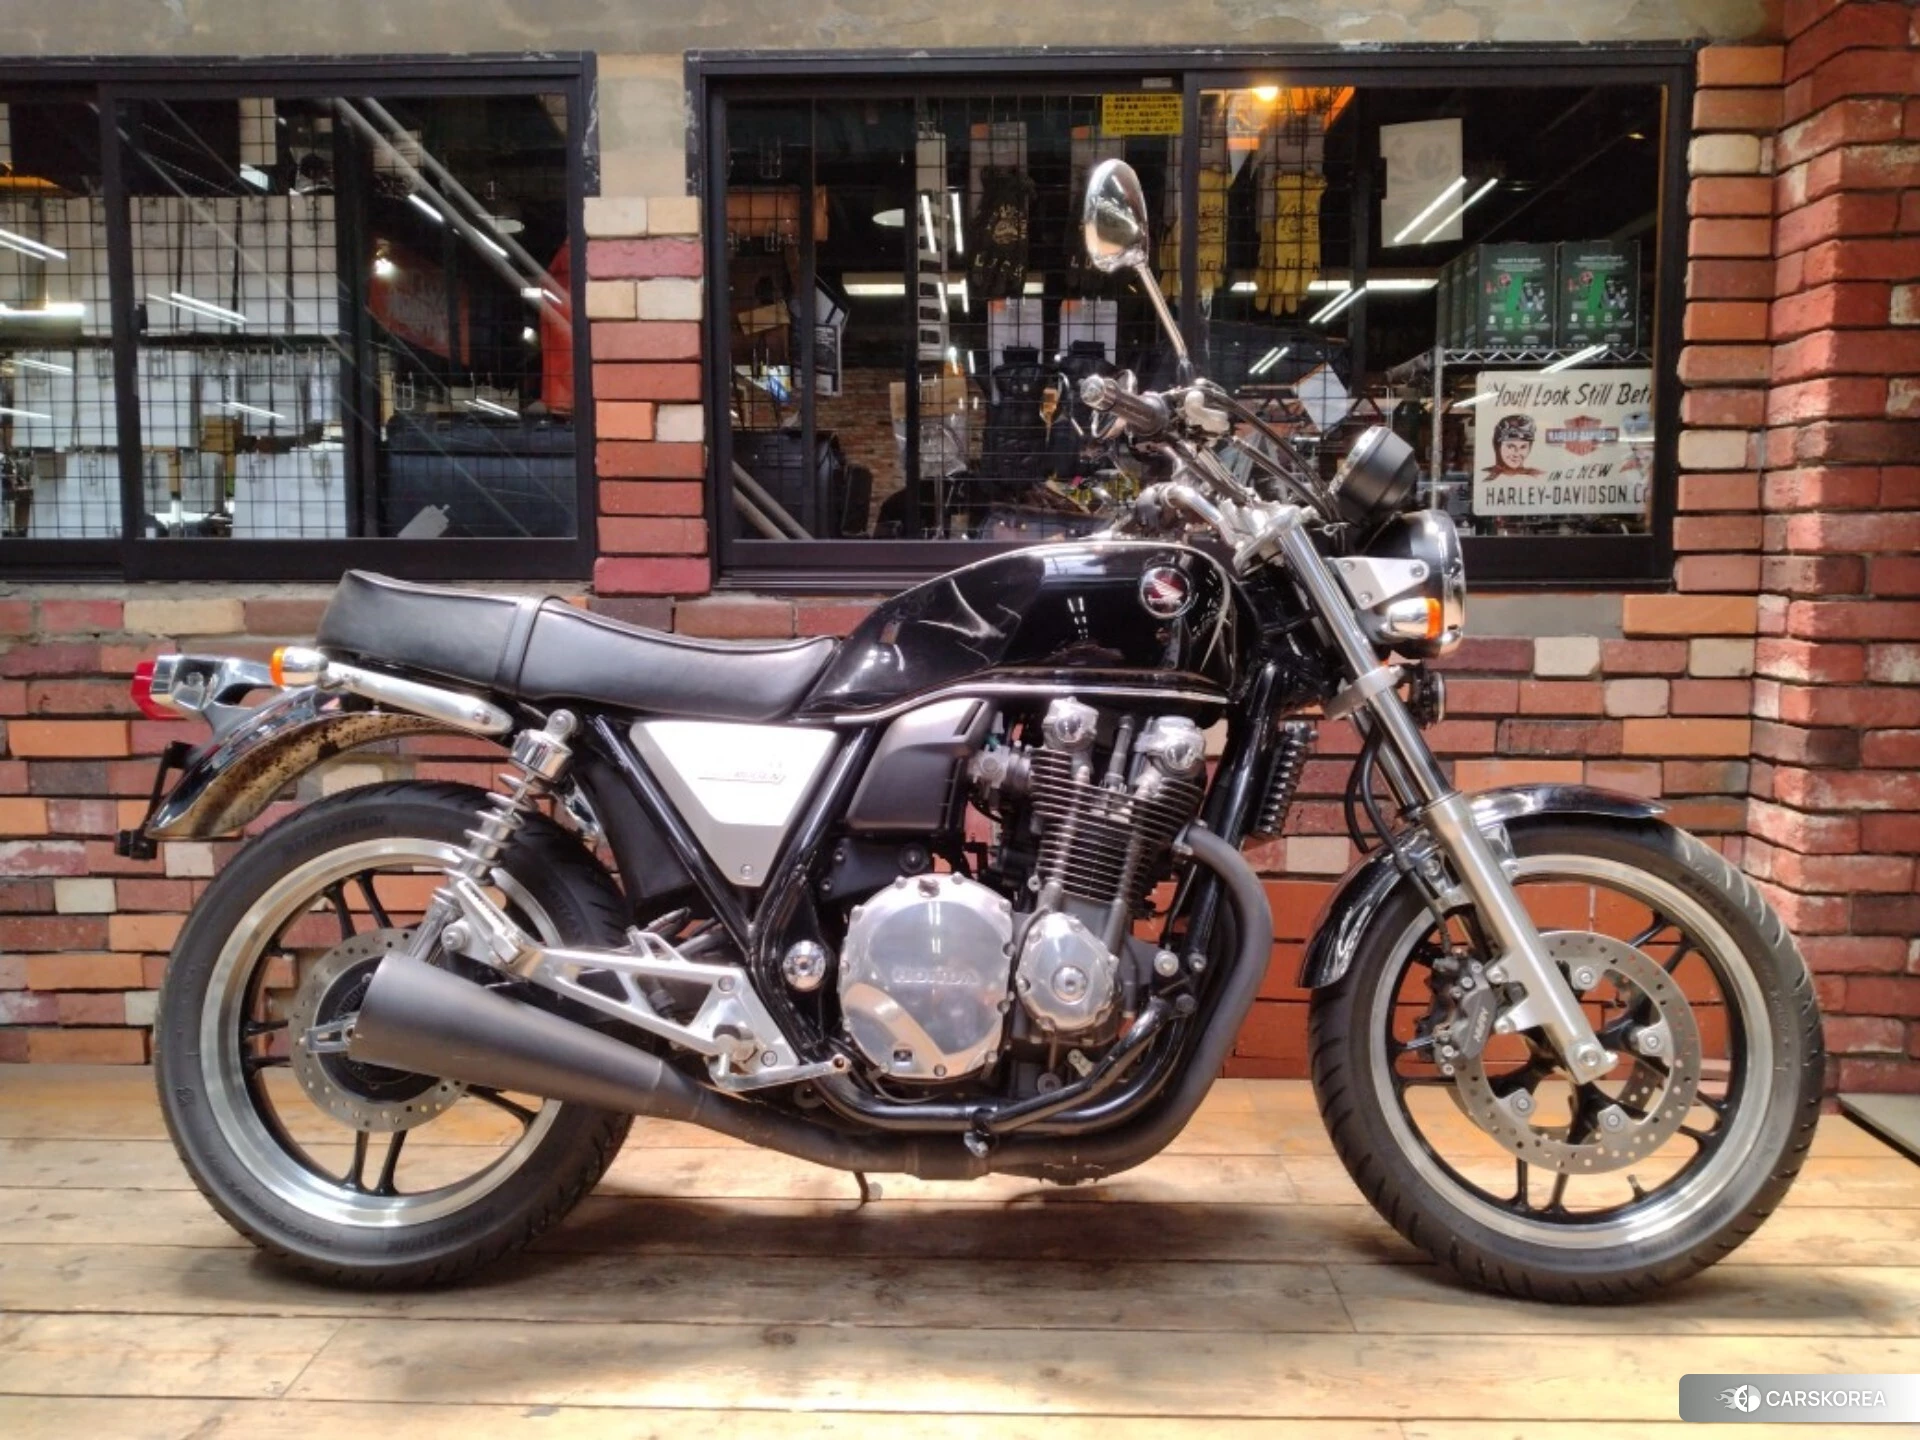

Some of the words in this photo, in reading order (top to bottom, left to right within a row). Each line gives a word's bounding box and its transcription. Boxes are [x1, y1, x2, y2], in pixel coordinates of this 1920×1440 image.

[1533, 384, 1571, 407] Look
[1574, 382, 1614, 407] Still
[1576, 462, 1613, 479] NEW
